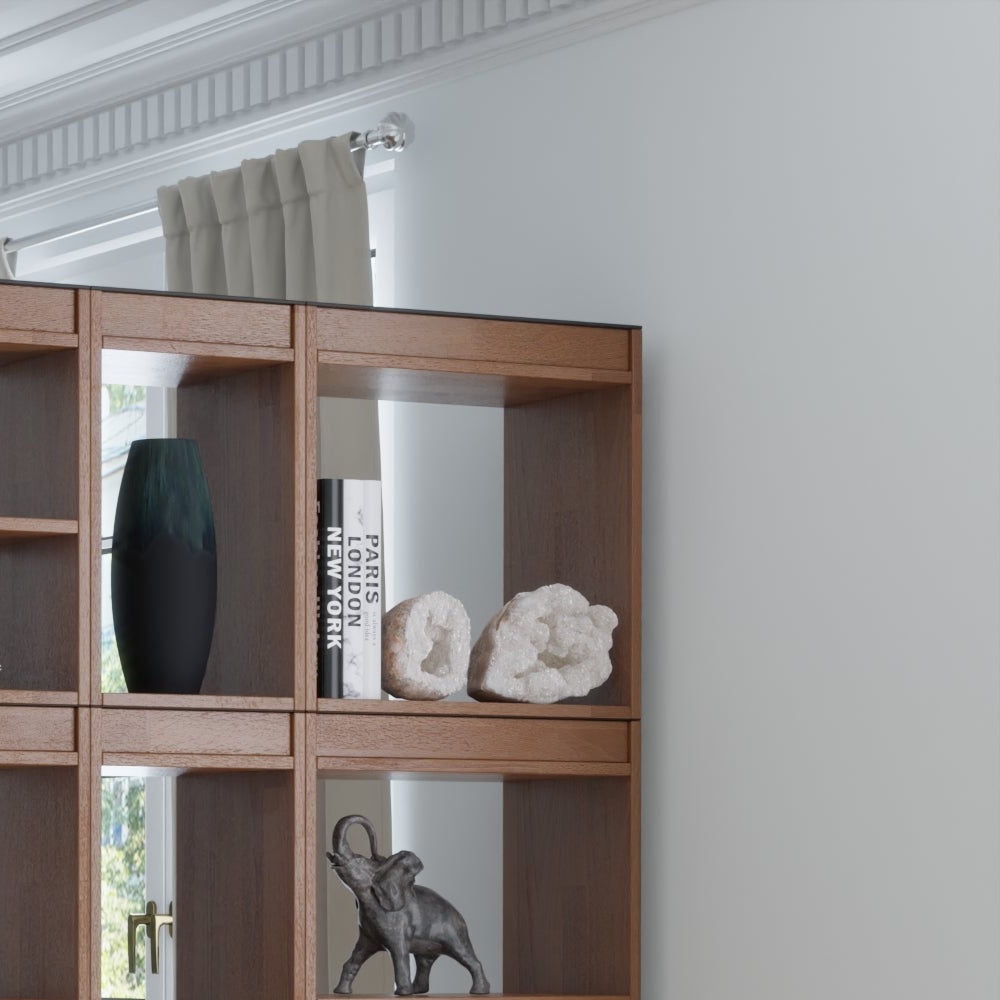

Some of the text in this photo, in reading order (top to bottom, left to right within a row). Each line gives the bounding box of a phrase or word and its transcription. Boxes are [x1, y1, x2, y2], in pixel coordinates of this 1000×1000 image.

[326, 526, 342, 649] NEW YORK
[347, 536, 361, 627] LONDON
[365, 534, 379, 604] PARIS
